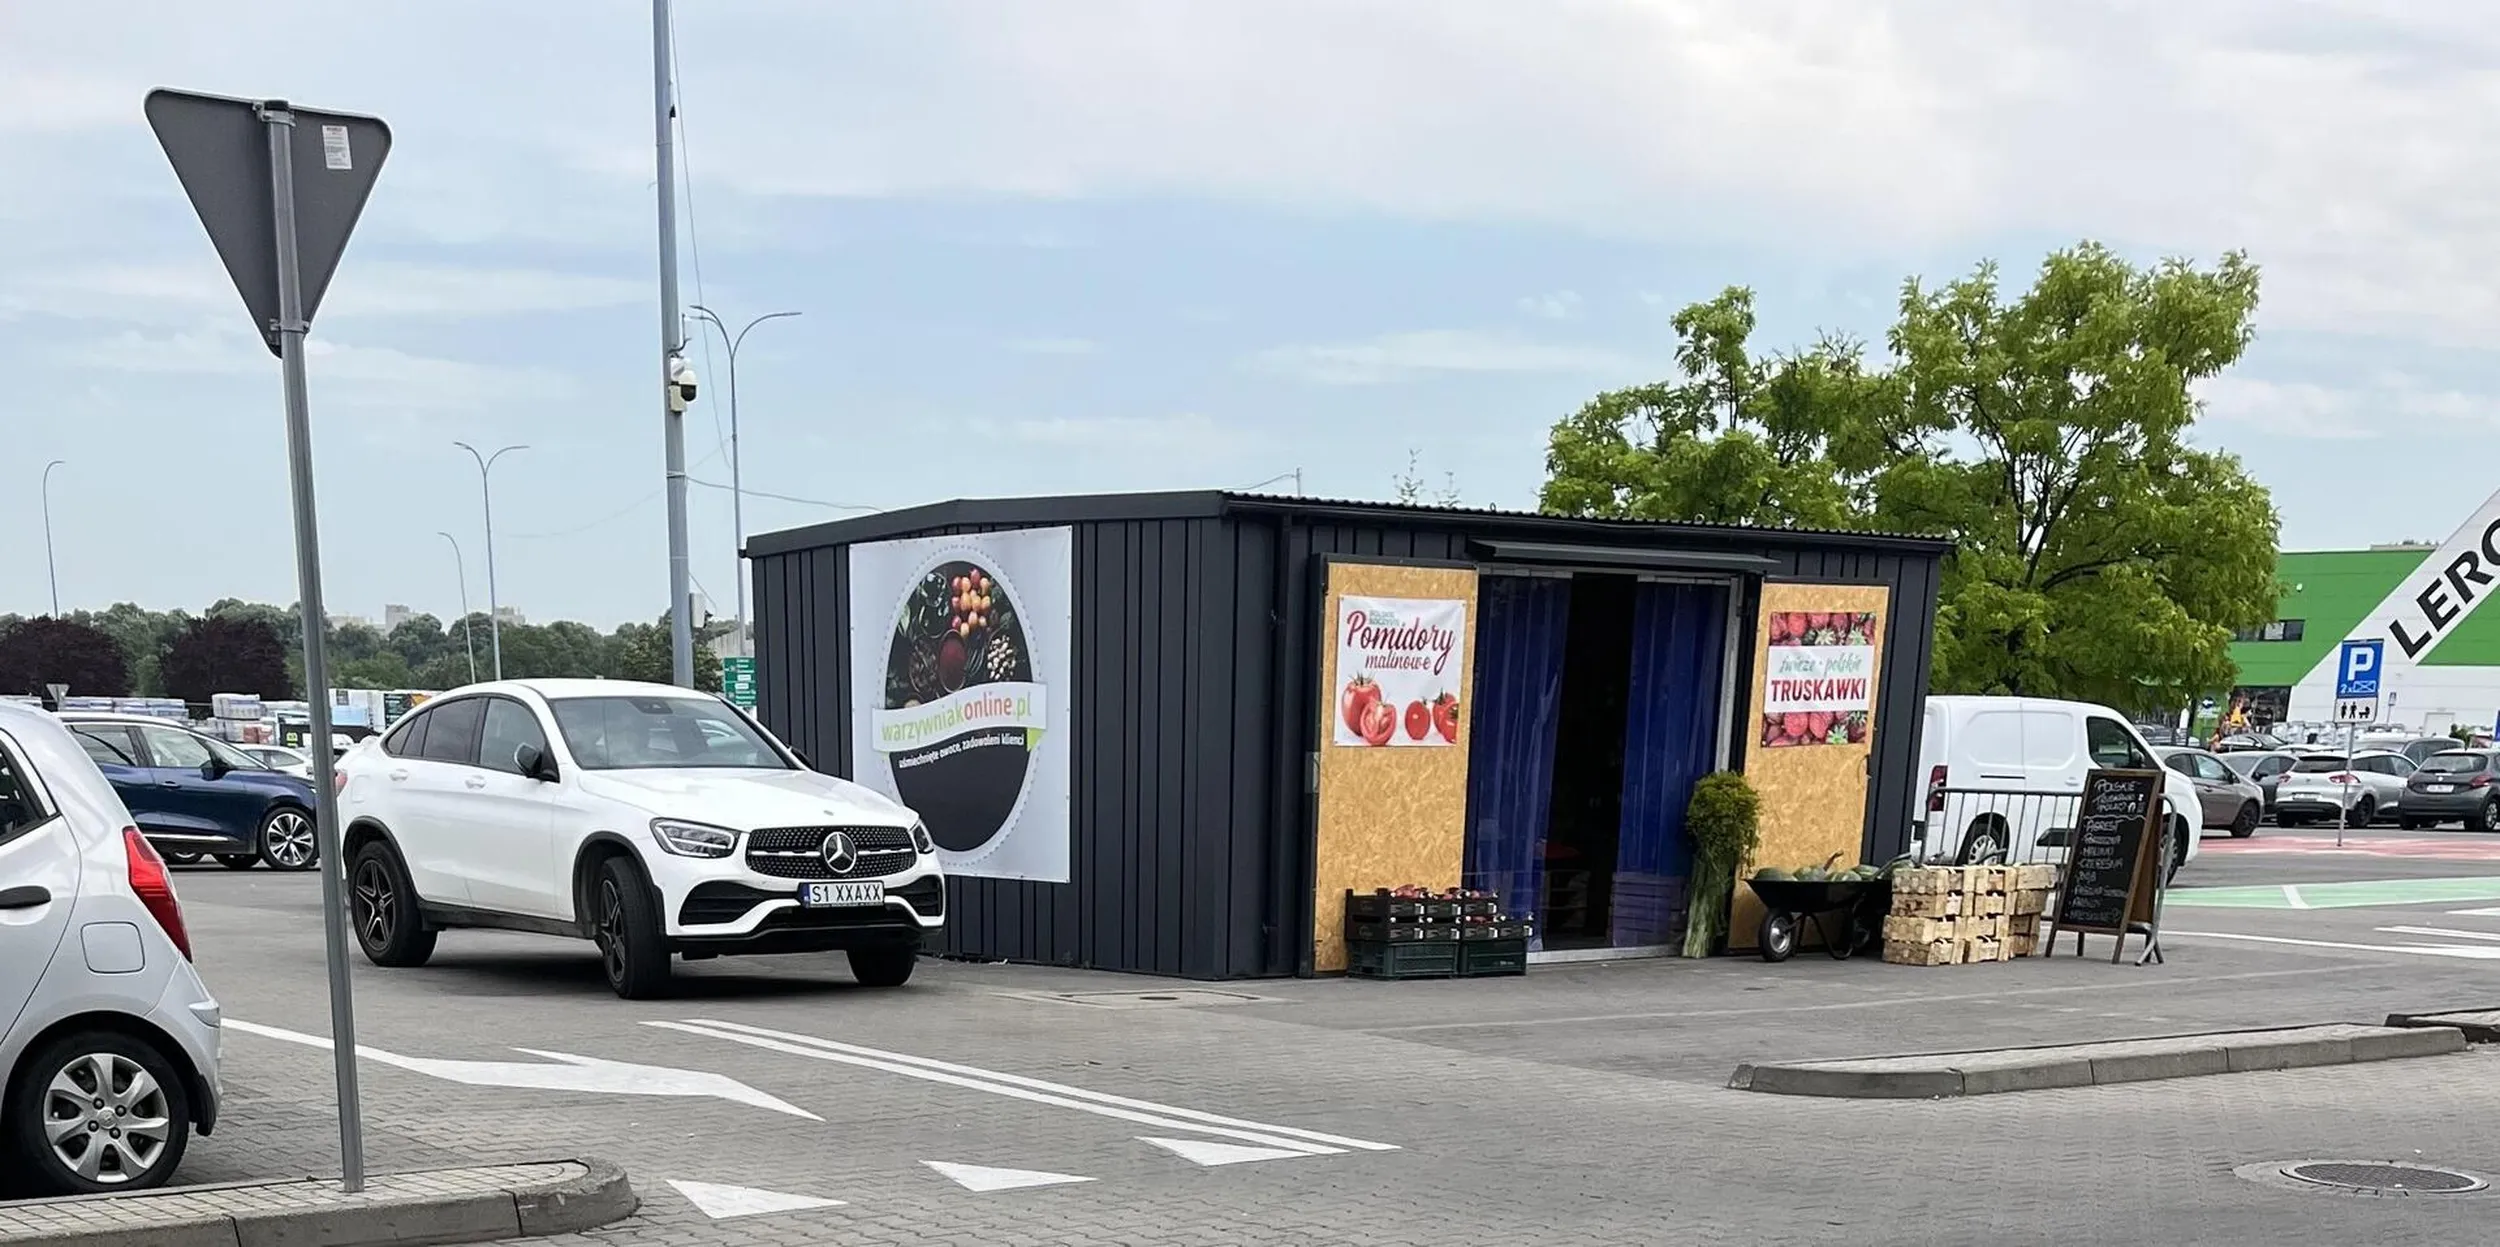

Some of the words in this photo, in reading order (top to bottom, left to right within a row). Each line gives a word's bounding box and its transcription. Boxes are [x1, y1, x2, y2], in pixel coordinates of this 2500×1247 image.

[1347, 610, 1456, 676] Pomidory
[1365, 650, 1431, 670] malinowe
[2347, 647, 2374, 680] P
[1771, 679, 1866, 702] TRUSKAWKI
[882, 691, 1032, 743] warzywniakonline.pl
[812, 885, 829, 903] S1
[836, 884, 880, 901] XXAXX
